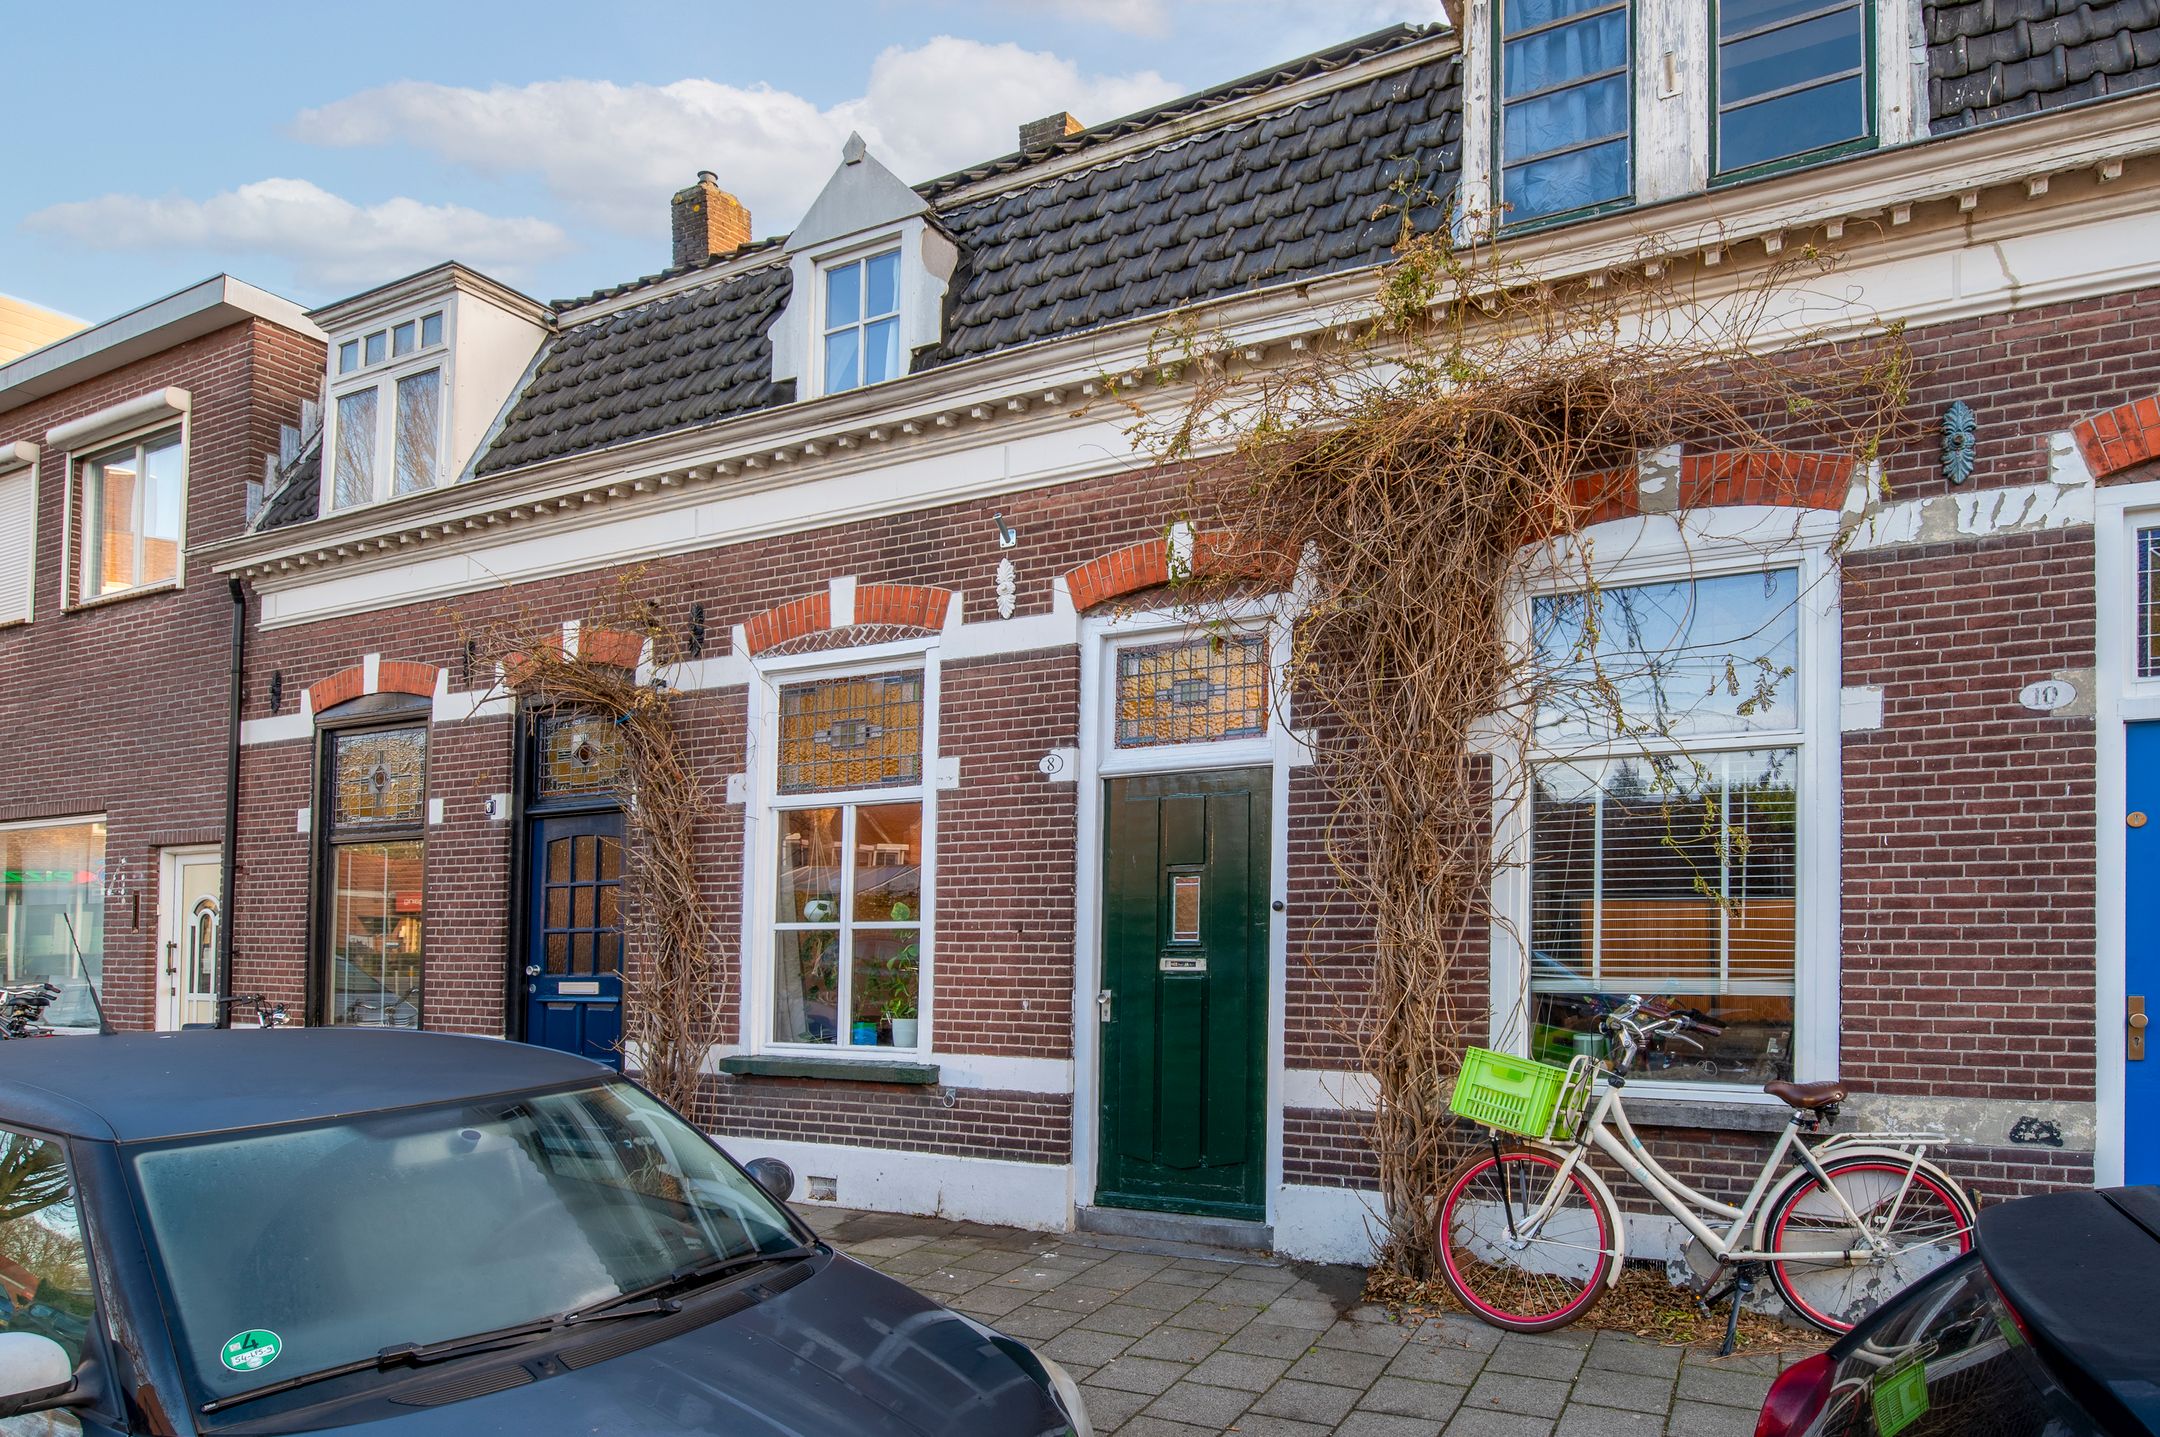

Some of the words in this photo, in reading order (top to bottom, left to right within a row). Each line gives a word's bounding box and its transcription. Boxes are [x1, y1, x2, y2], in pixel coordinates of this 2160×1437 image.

[2033, 686, 2058, 705] 10
[1047, 757, 1055, 771] 8
[242, 1333, 259, 1349] 4
